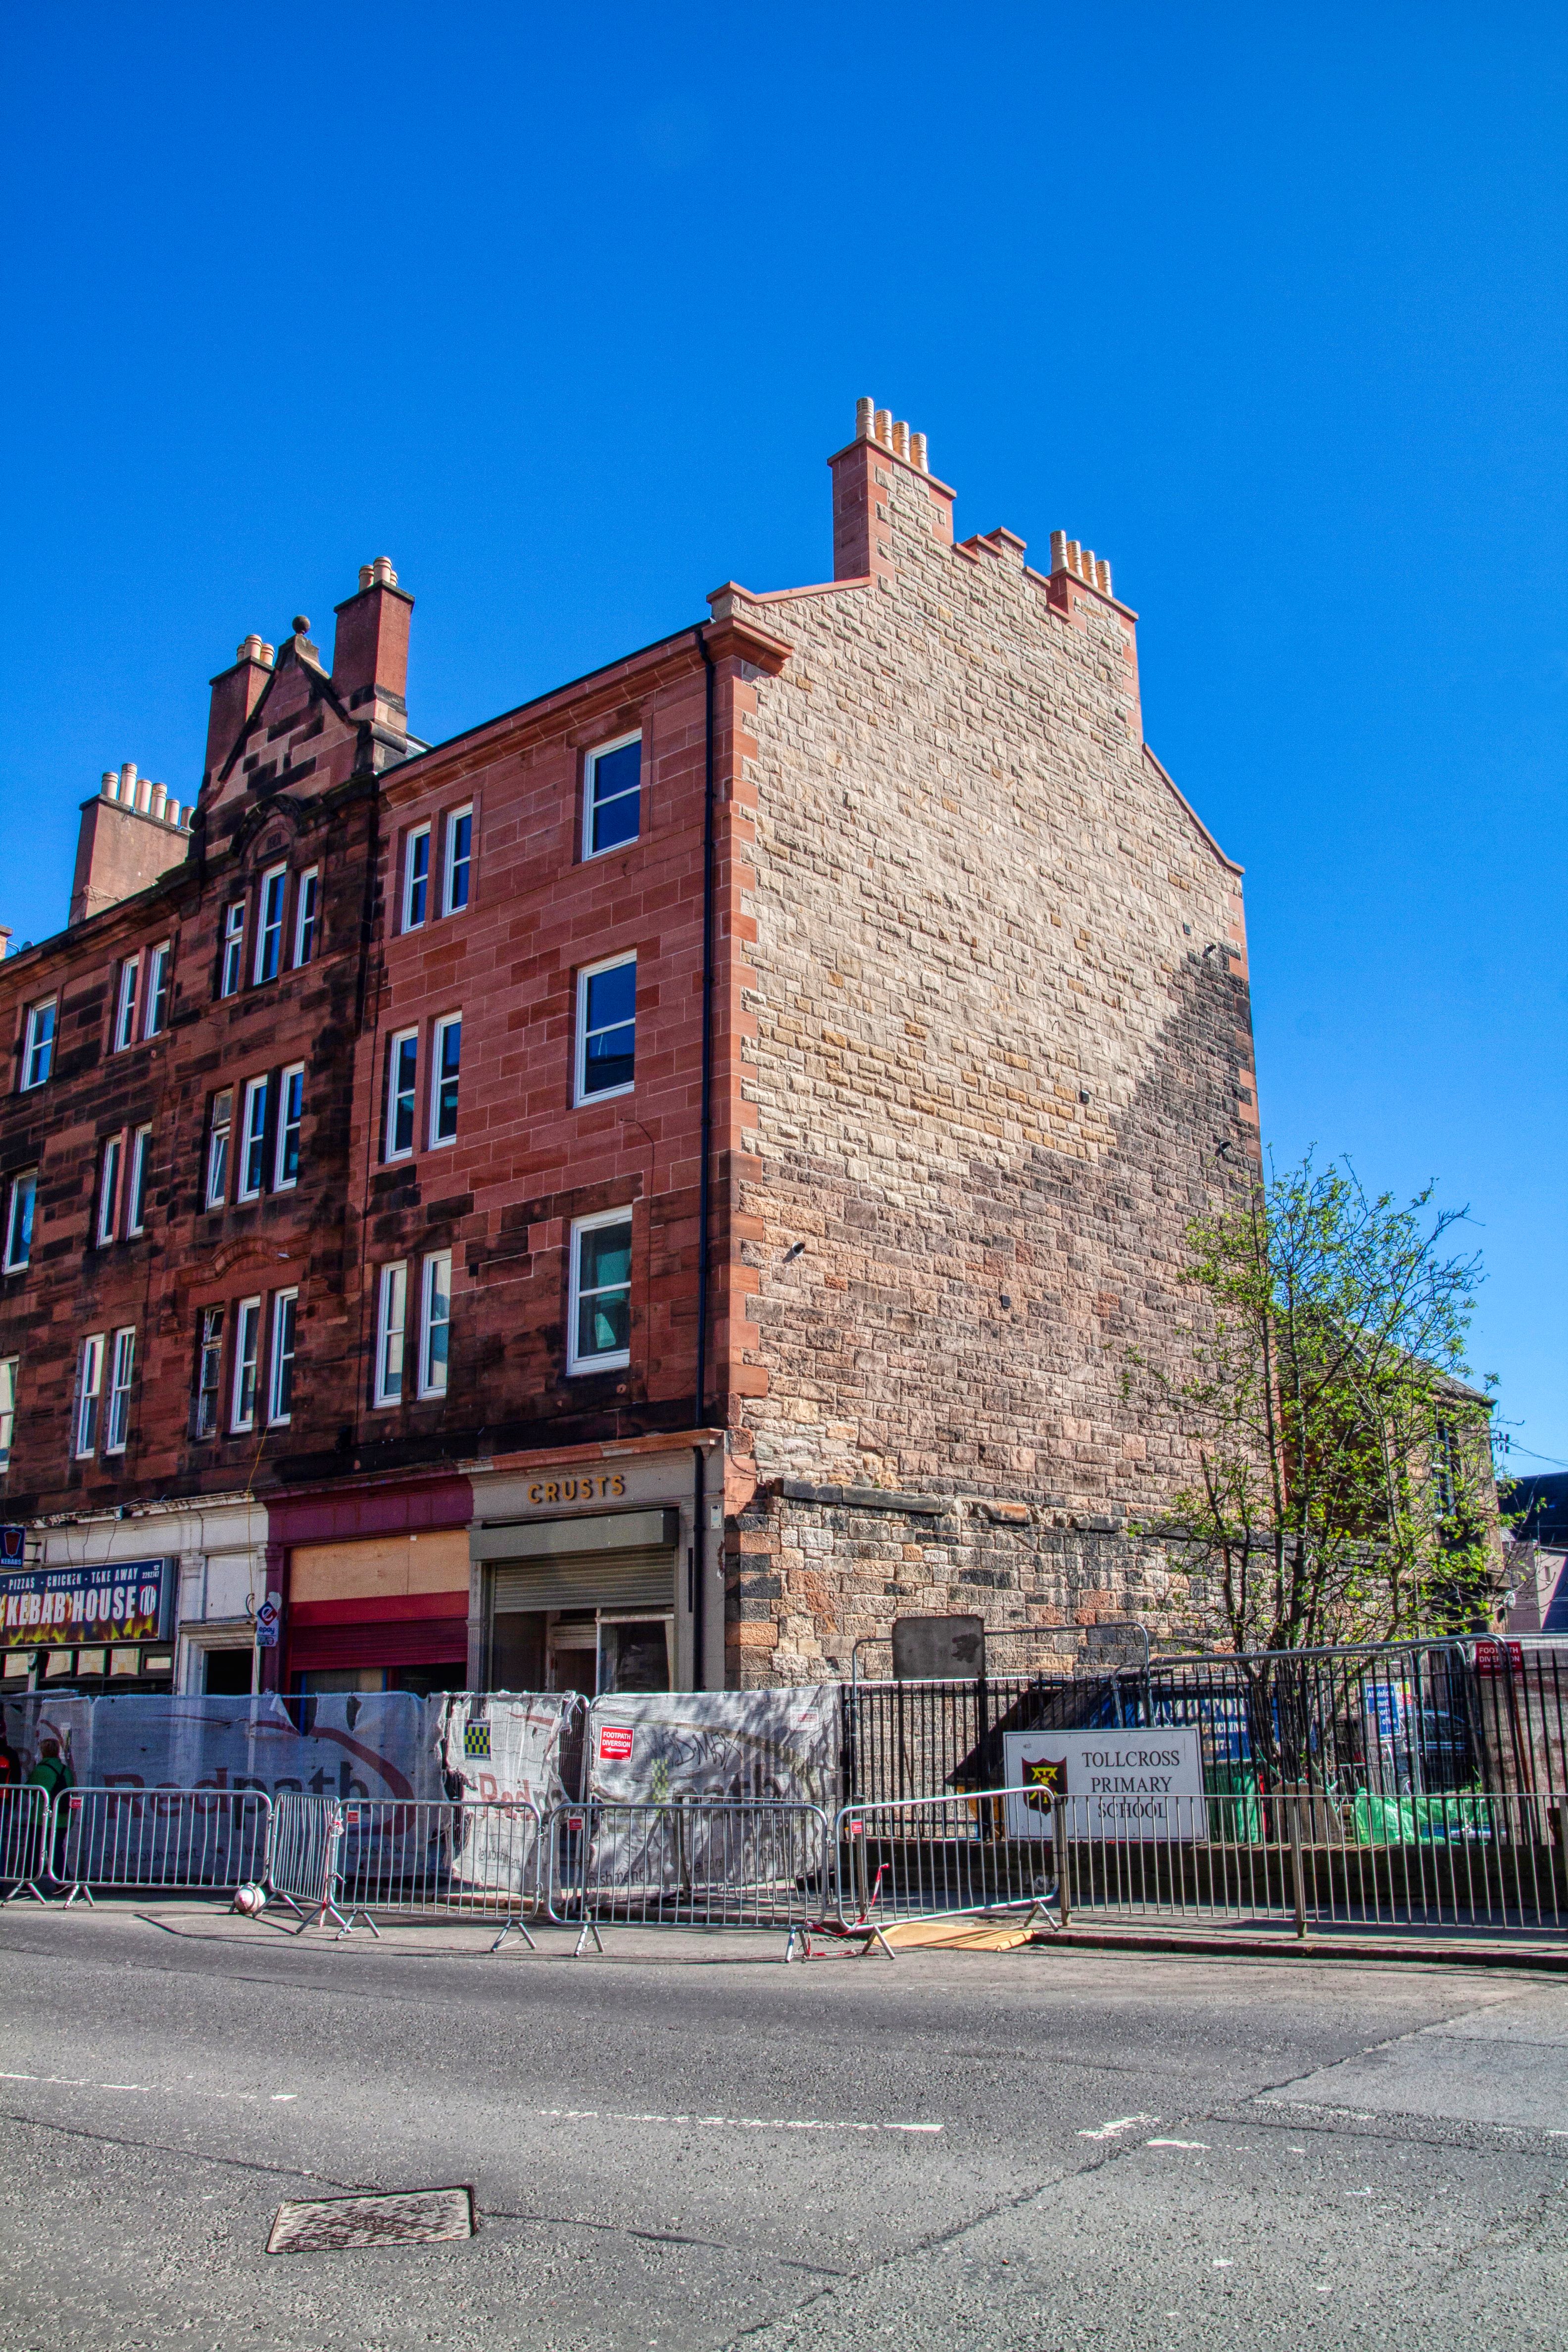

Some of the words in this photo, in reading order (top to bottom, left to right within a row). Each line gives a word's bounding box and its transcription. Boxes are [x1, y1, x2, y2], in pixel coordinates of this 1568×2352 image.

[527, 1474, 625, 1504] CRUSTS
[8, 1577, 35, 1590] PIZZAS
[47, 1573, 82, 1587] CHICKEN
[92, 1570, 111, 1583] TAKE
[114, 1568, 139, 1581] AWAY
[6, 1591, 66, 1626] KEBAB
[71, 1585, 137, 1622] HOUSE
[602, 1739, 631, 1748] DIVERSION
[603, 1731, 631, 1740] FOOTPATH
[1081, 1750, 1180, 1767] TOLLCROSS
[1091, 1776, 1173, 1792] PRIMARY
[102, 1761, 369, 1830] Redpath
[1098, 1802, 1168, 1818] SCHOOL
